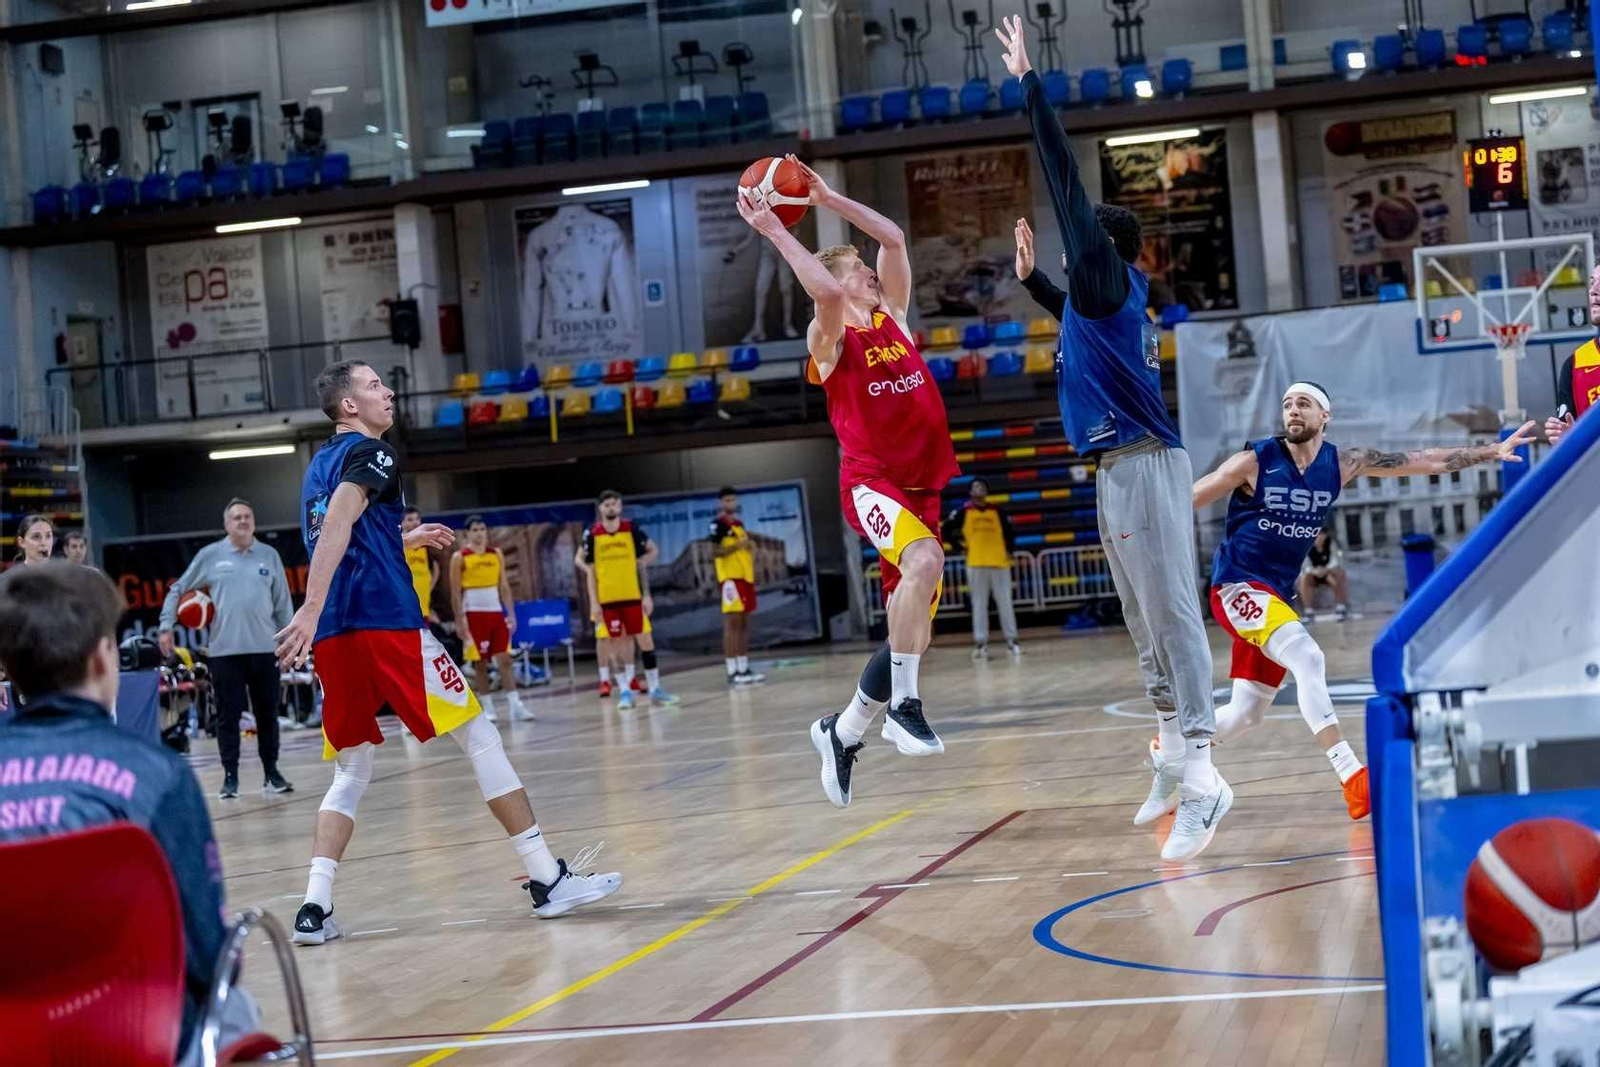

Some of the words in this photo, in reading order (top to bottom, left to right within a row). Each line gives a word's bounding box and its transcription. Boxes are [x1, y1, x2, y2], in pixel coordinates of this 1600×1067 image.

[1497, 162, 1513, 184] 6
[868, 370, 924, 396] endesa
[1264, 486, 1332, 513] ESP
[867, 503, 892, 540] ESP
[1258, 518, 1322, 538] endesa
[1231, 591, 1263, 621] ESP
[432, 653, 465, 693] ESP
[0, 753, 137, 800] ALAJARA
